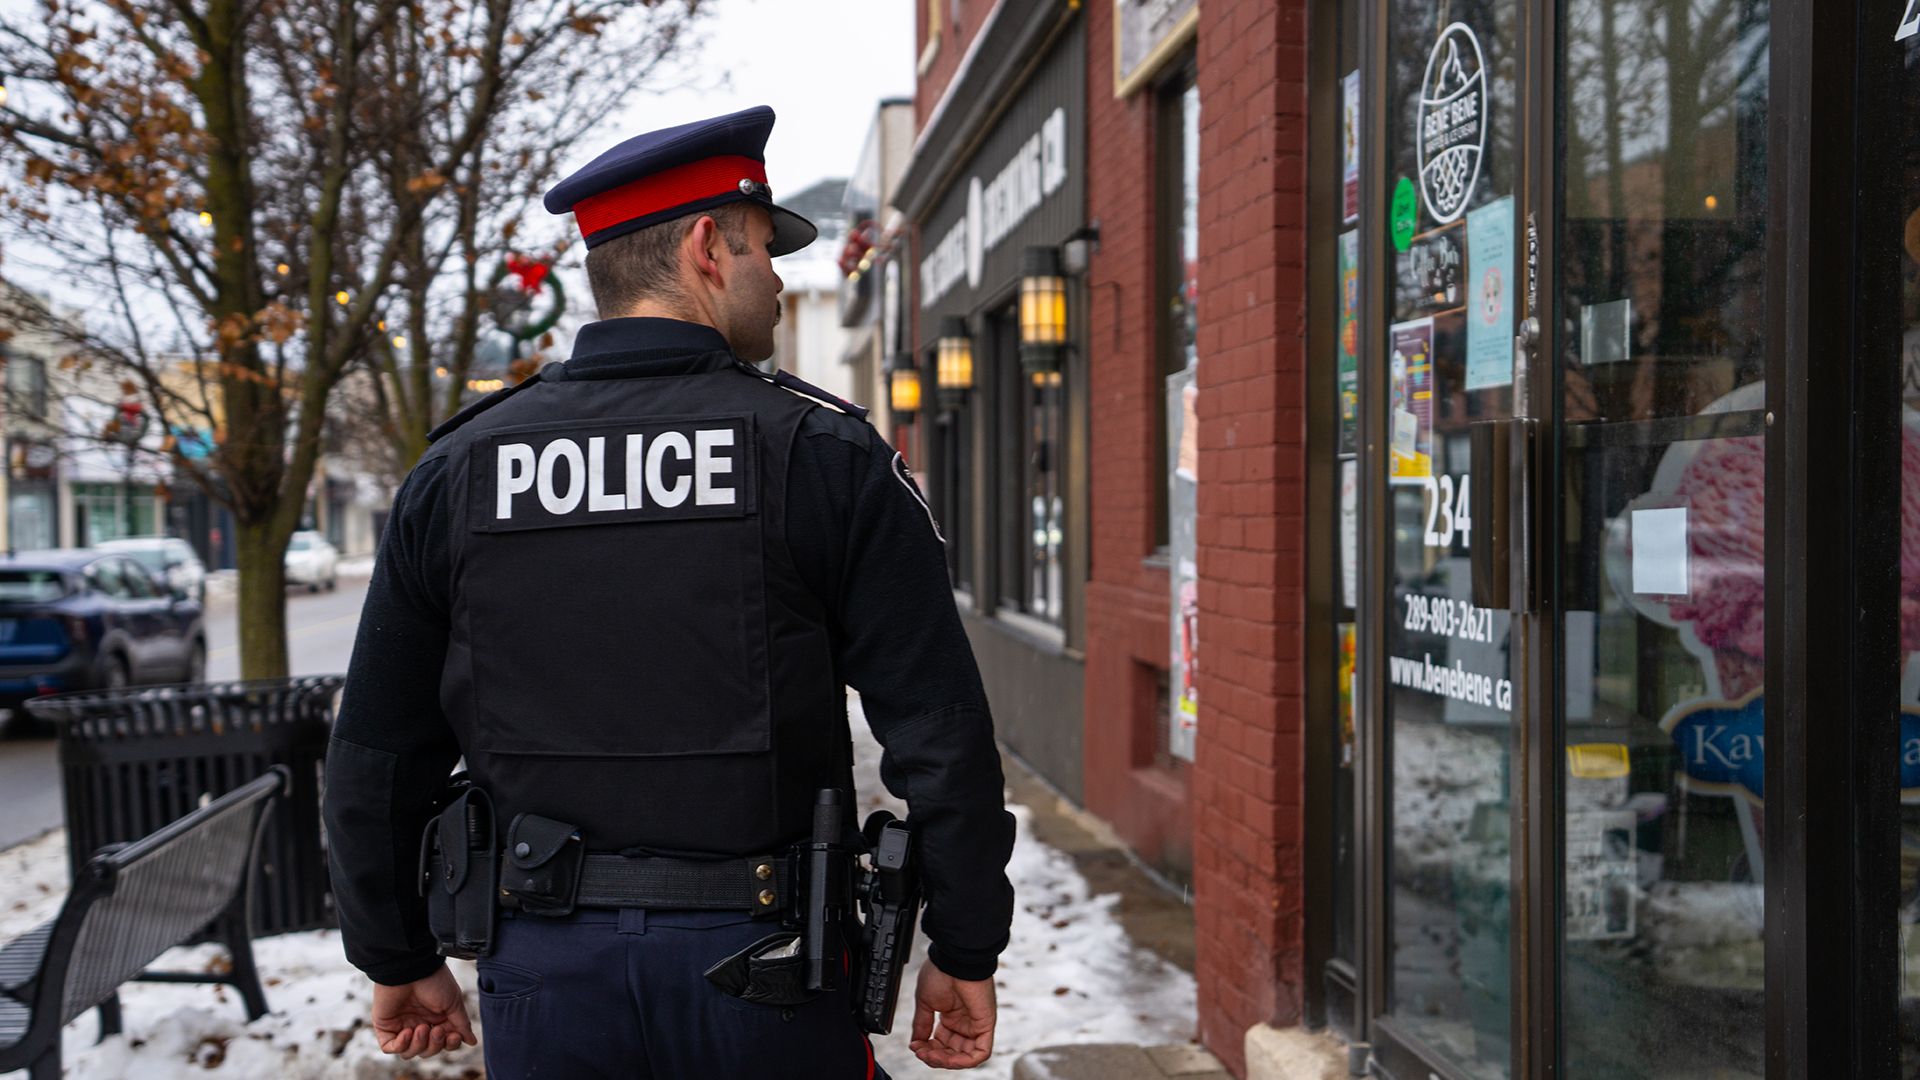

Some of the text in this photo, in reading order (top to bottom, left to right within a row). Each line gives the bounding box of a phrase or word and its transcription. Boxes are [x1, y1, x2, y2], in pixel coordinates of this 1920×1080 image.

[1425, 91, 1477, 138] BENE BENE
[496, 428, 736, 520] POLICE
[1424, 474, 1472, 548] 234
[1404, 594, 1493, 643] 289-803-2621
